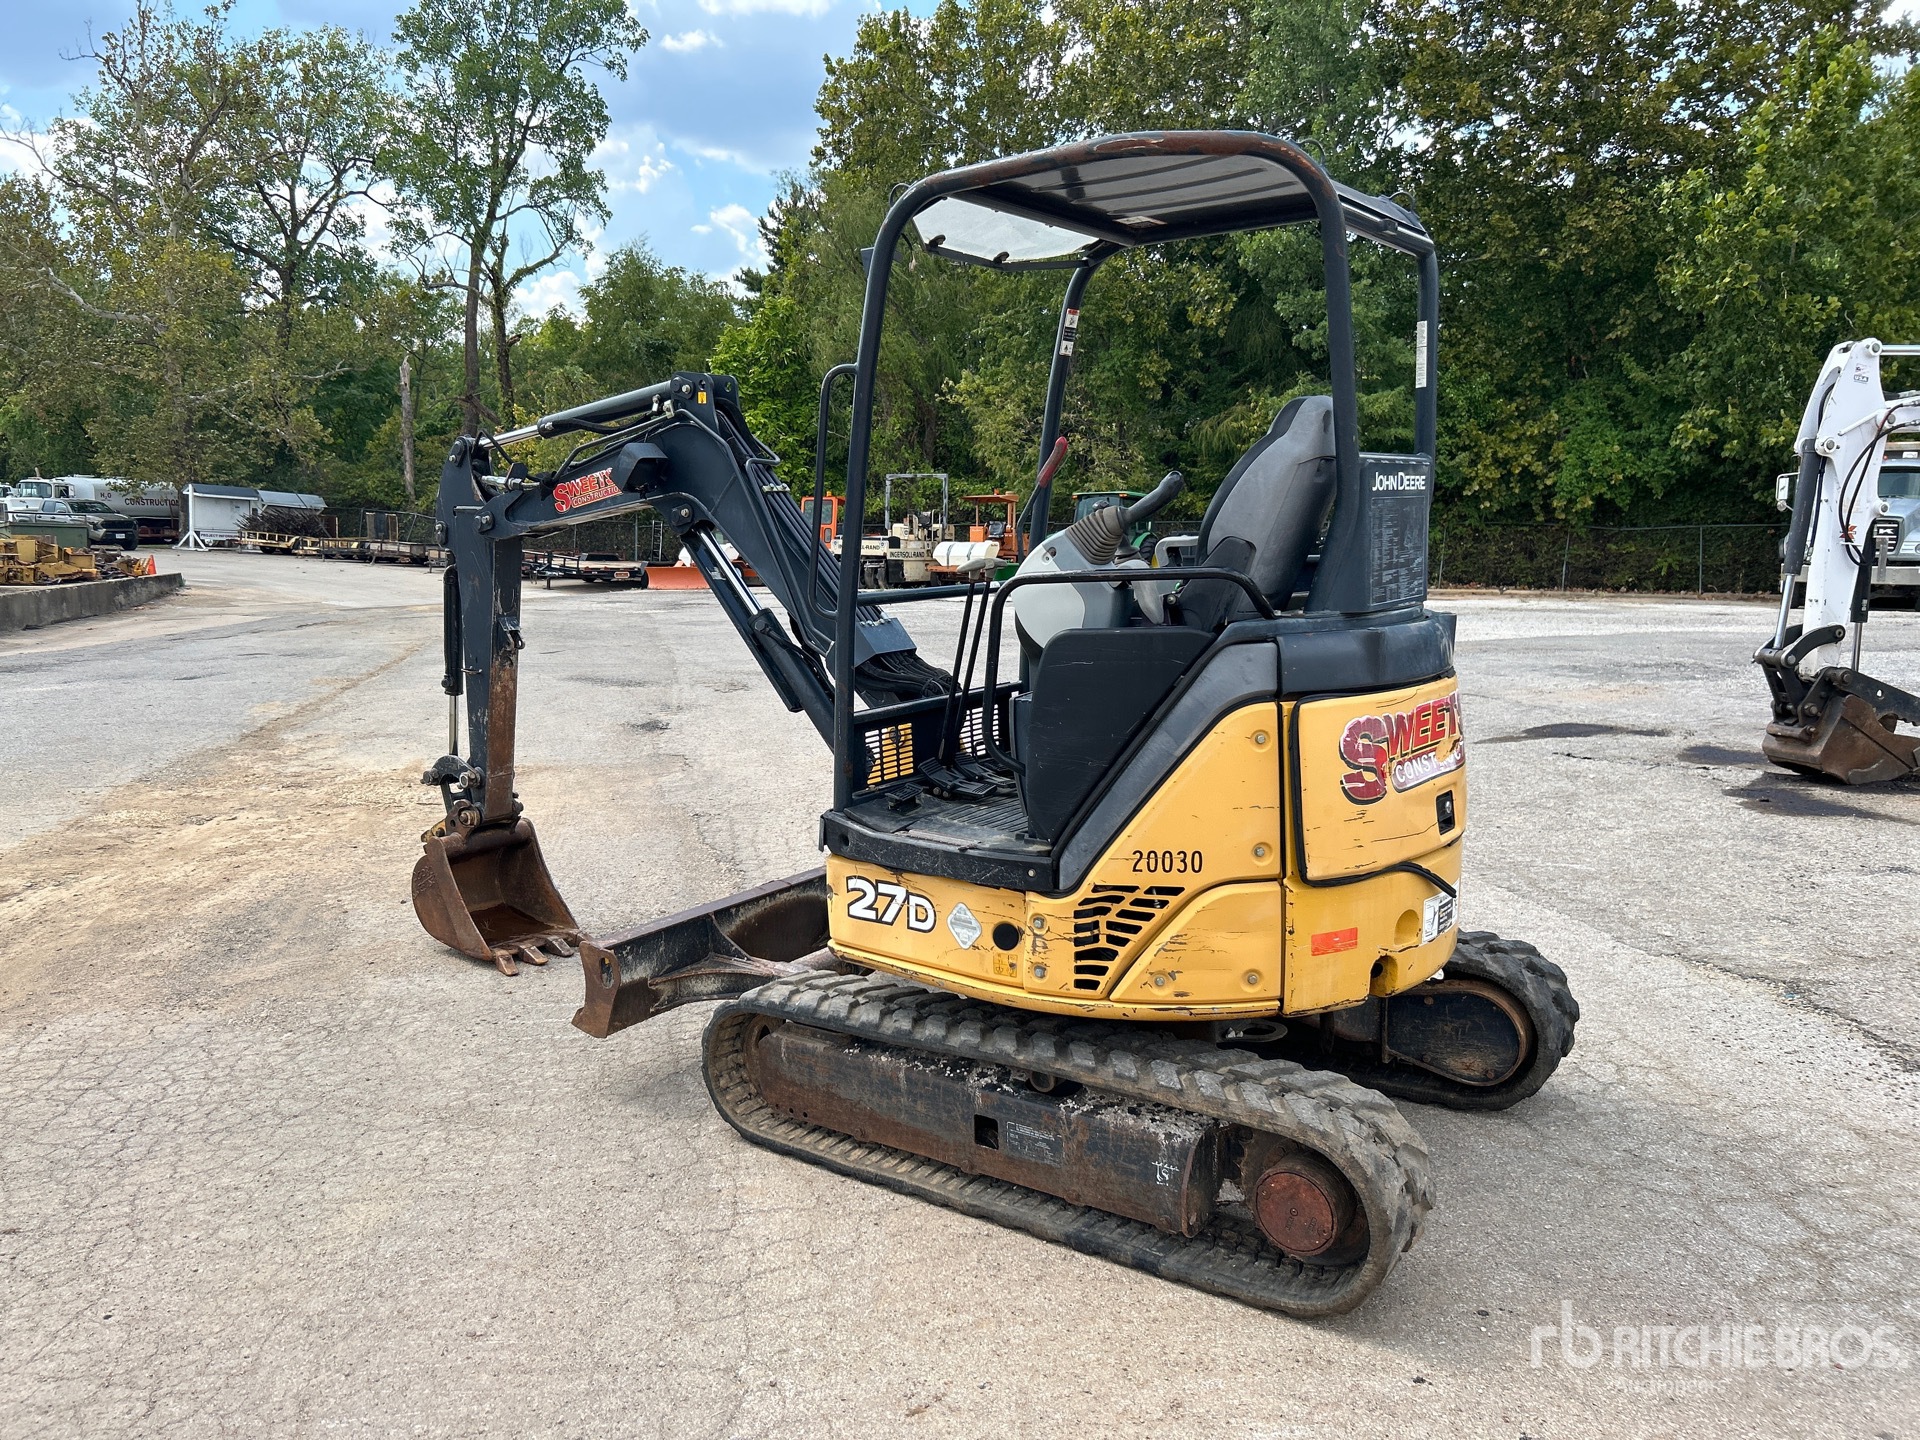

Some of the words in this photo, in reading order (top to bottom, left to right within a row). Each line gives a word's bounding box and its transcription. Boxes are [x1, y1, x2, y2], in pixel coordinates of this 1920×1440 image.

[1372, 471, 1397, 491] JOHN
[1398, 471, 1426, 490] DEERE
[573, 485, 621, 506] CONSTRUCTIO
[1132, 849, 1203, 873] 20030
[846, 875, 937, 933] 27D
